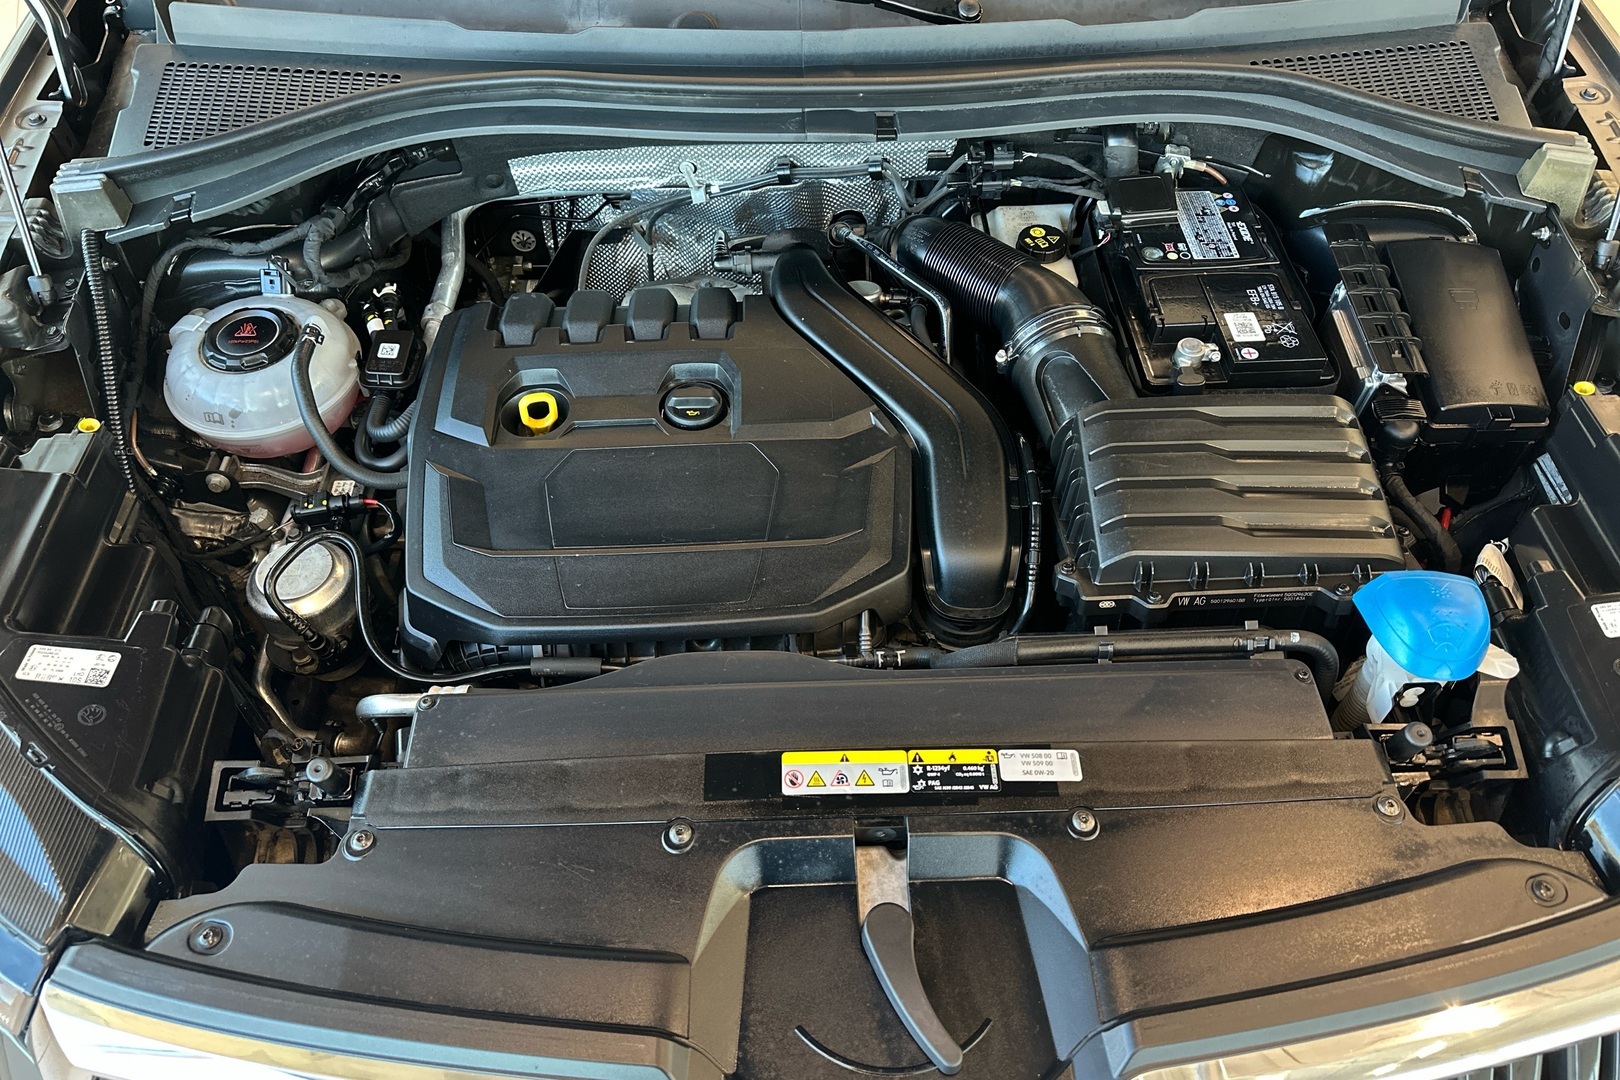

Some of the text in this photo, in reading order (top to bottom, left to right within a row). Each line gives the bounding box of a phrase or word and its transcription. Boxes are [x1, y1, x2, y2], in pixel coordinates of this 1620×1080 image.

[1246, 289, 1261, 307] EFB+
[1177, 596, 1191, 606] VW
[1193, 596, 1207, 606] AG
